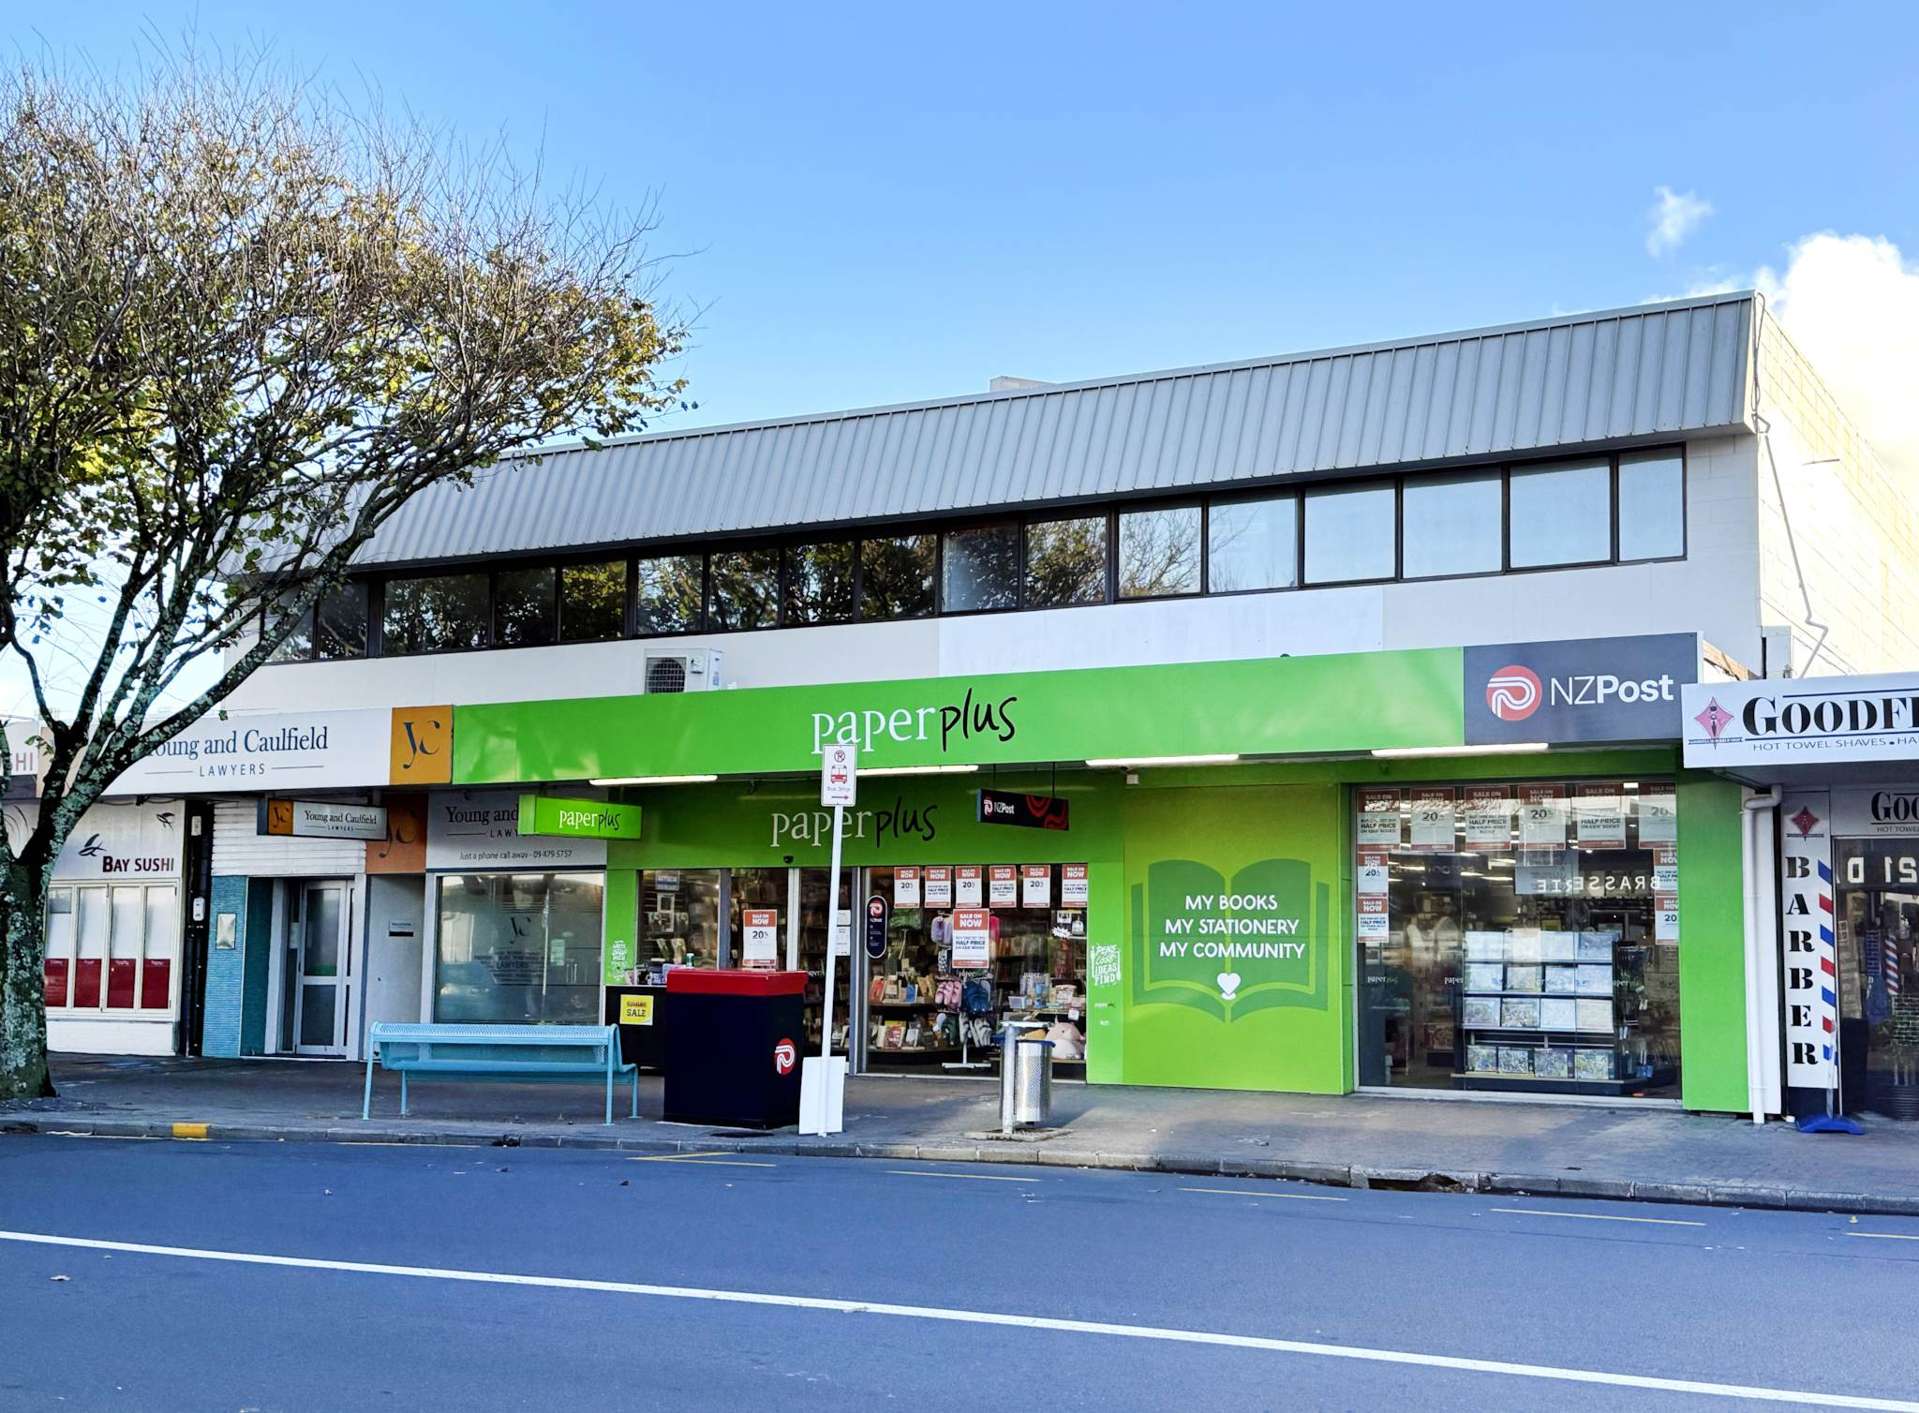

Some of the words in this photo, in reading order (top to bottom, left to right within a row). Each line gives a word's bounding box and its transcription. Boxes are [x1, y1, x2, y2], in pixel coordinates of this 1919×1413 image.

[1551, 674, 1674, 706] NZPost
[151, 739, 200, 761] oung
[203, 730, 237, 755] and
[244, 726, 328, 753] Caulfield
[1753, 742, 1782, 752] HOT
[1786, 740, 1833, 750] TOWEL
[1835, 737, 1887, 748] SHAVES
[199, 763, 266, 777] LAWYERS
[304, 810, 329, 825] Young
[329, 812, 343, 823] and
[345, 813, 377, 825] Caulfield
[446, 806, 490, 826] Young
[478, 851, 498, 861] phone
[500, 850, 511, 860] call
[102, 856, 131, 873] BAY
[135, 858, 175, 872] SUSHI
[1185, 895, 1214, 910] MY
[1219, 895, 1278, 910] BOOKS
[959, 919, 983, 928] NOW
[1165, 919, 1194, 934] MY
[1198, 919, 1299, 934] STATIONERY
[1159, 942, 1188, 957] MY
[1193, 942, 1305, 958] COMMUNITY
[1784, 856, 1820, 1066] BARBER
[626, 1008, 646, 1017] SALE
